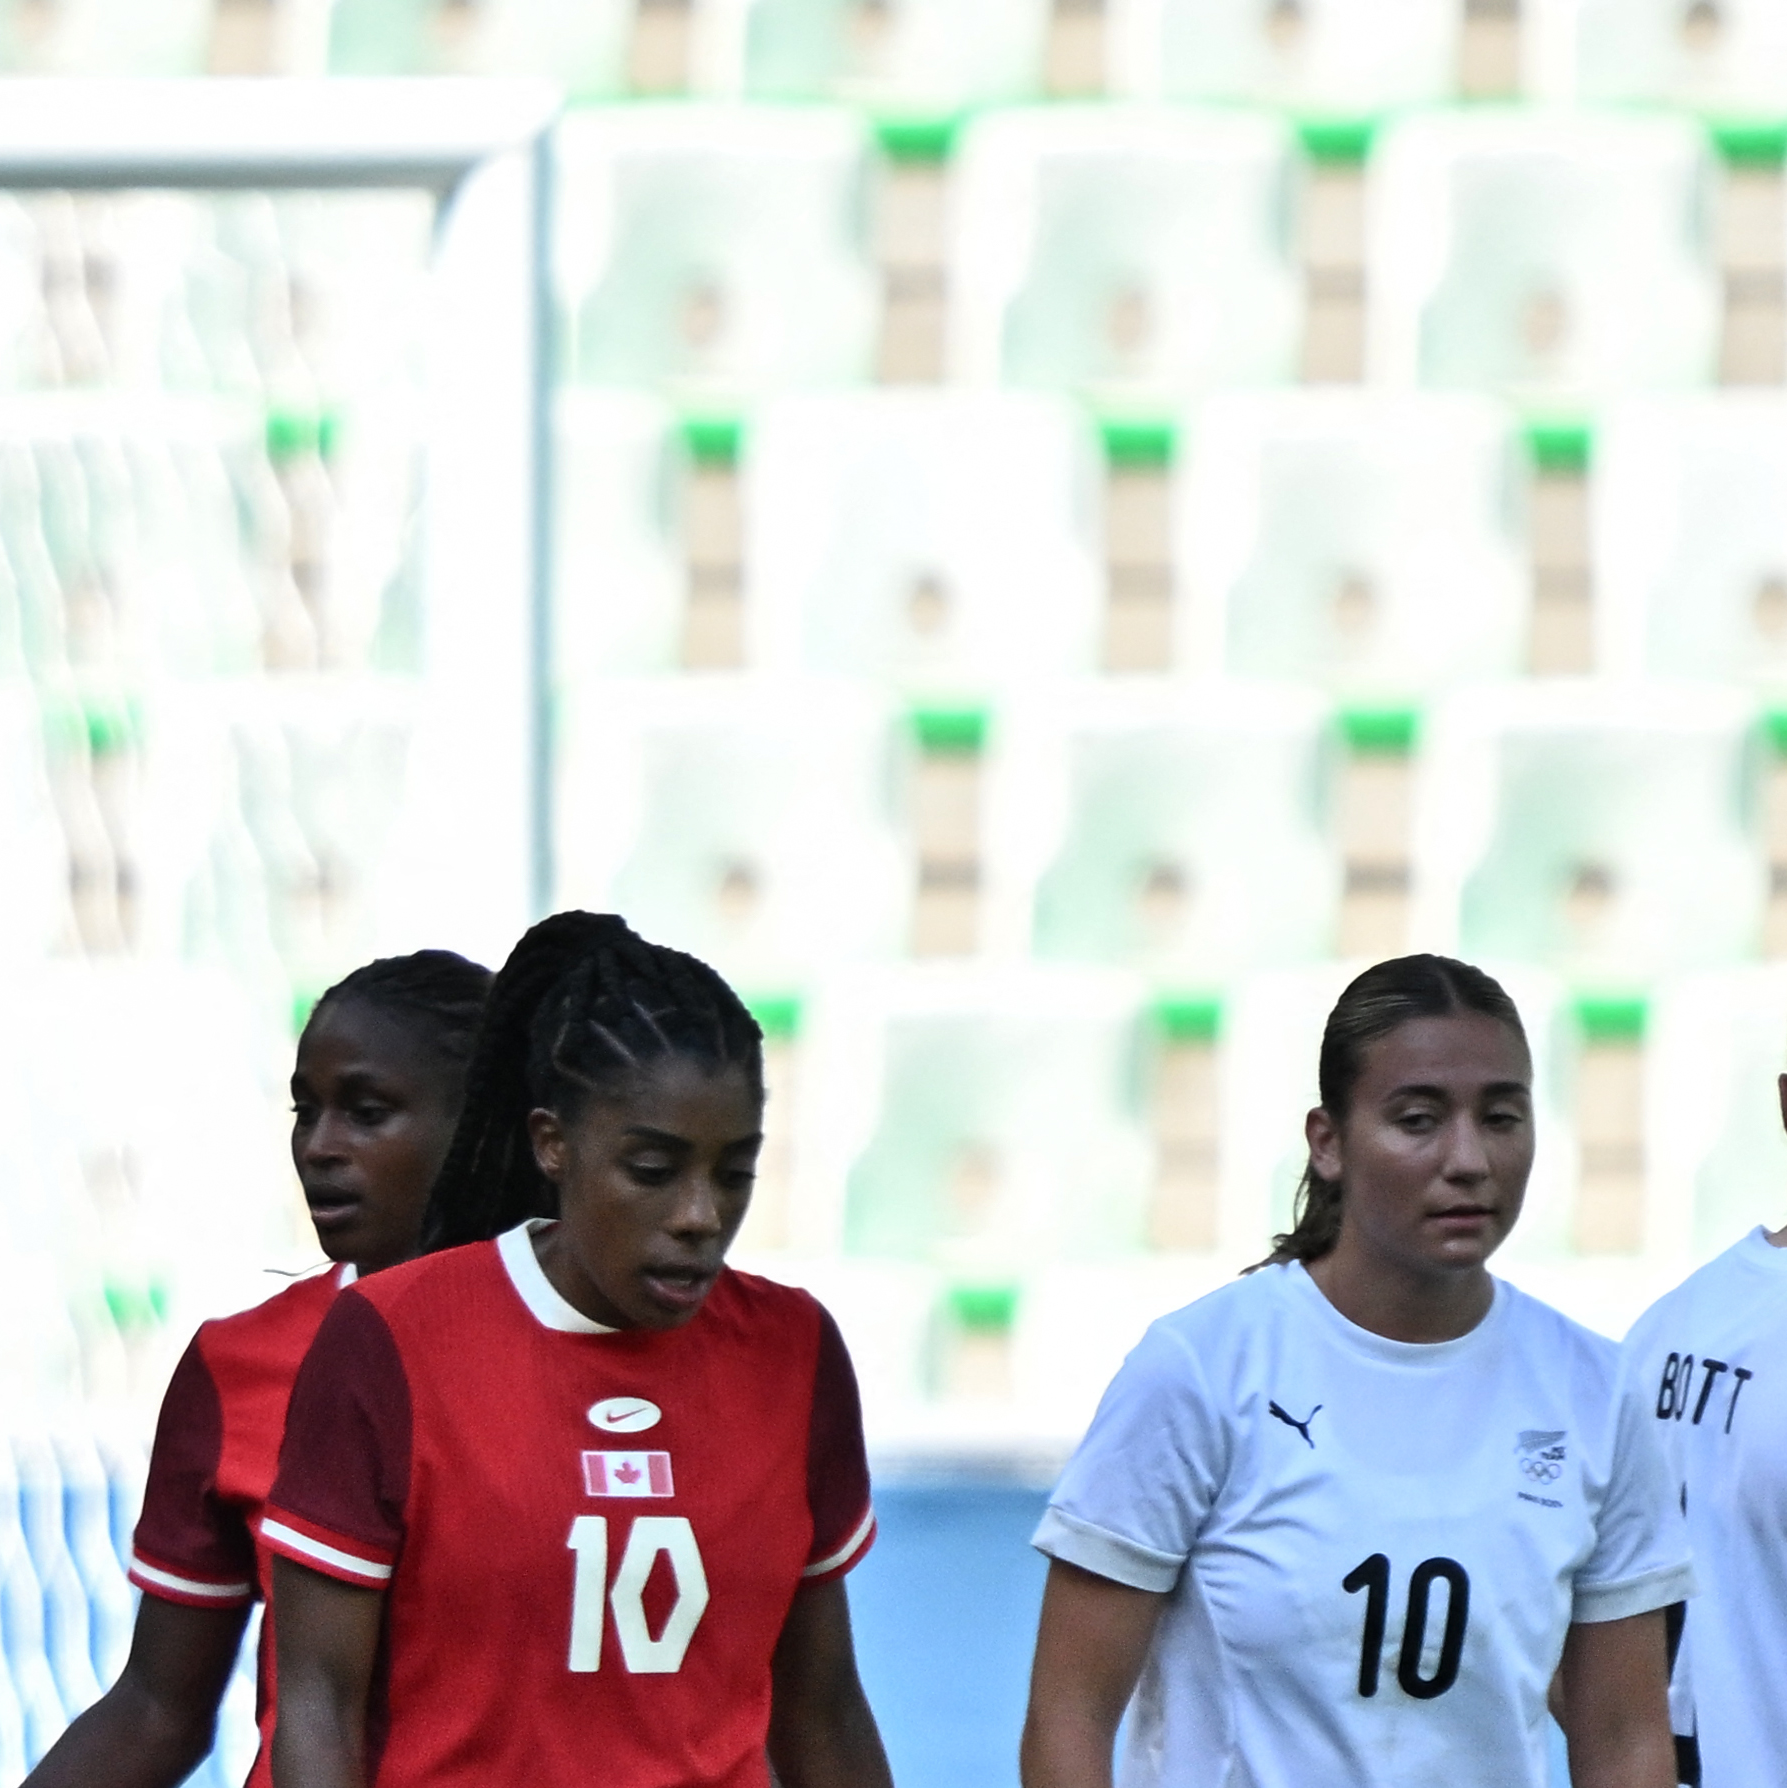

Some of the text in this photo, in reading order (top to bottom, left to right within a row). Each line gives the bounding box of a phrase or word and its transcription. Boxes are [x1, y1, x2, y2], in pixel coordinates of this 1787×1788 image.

[1655, 1351, 1754, 1435] BOTT
[565, 1515, 710, 1674] 10
[1342, 1552, 1471, 1700] 10
